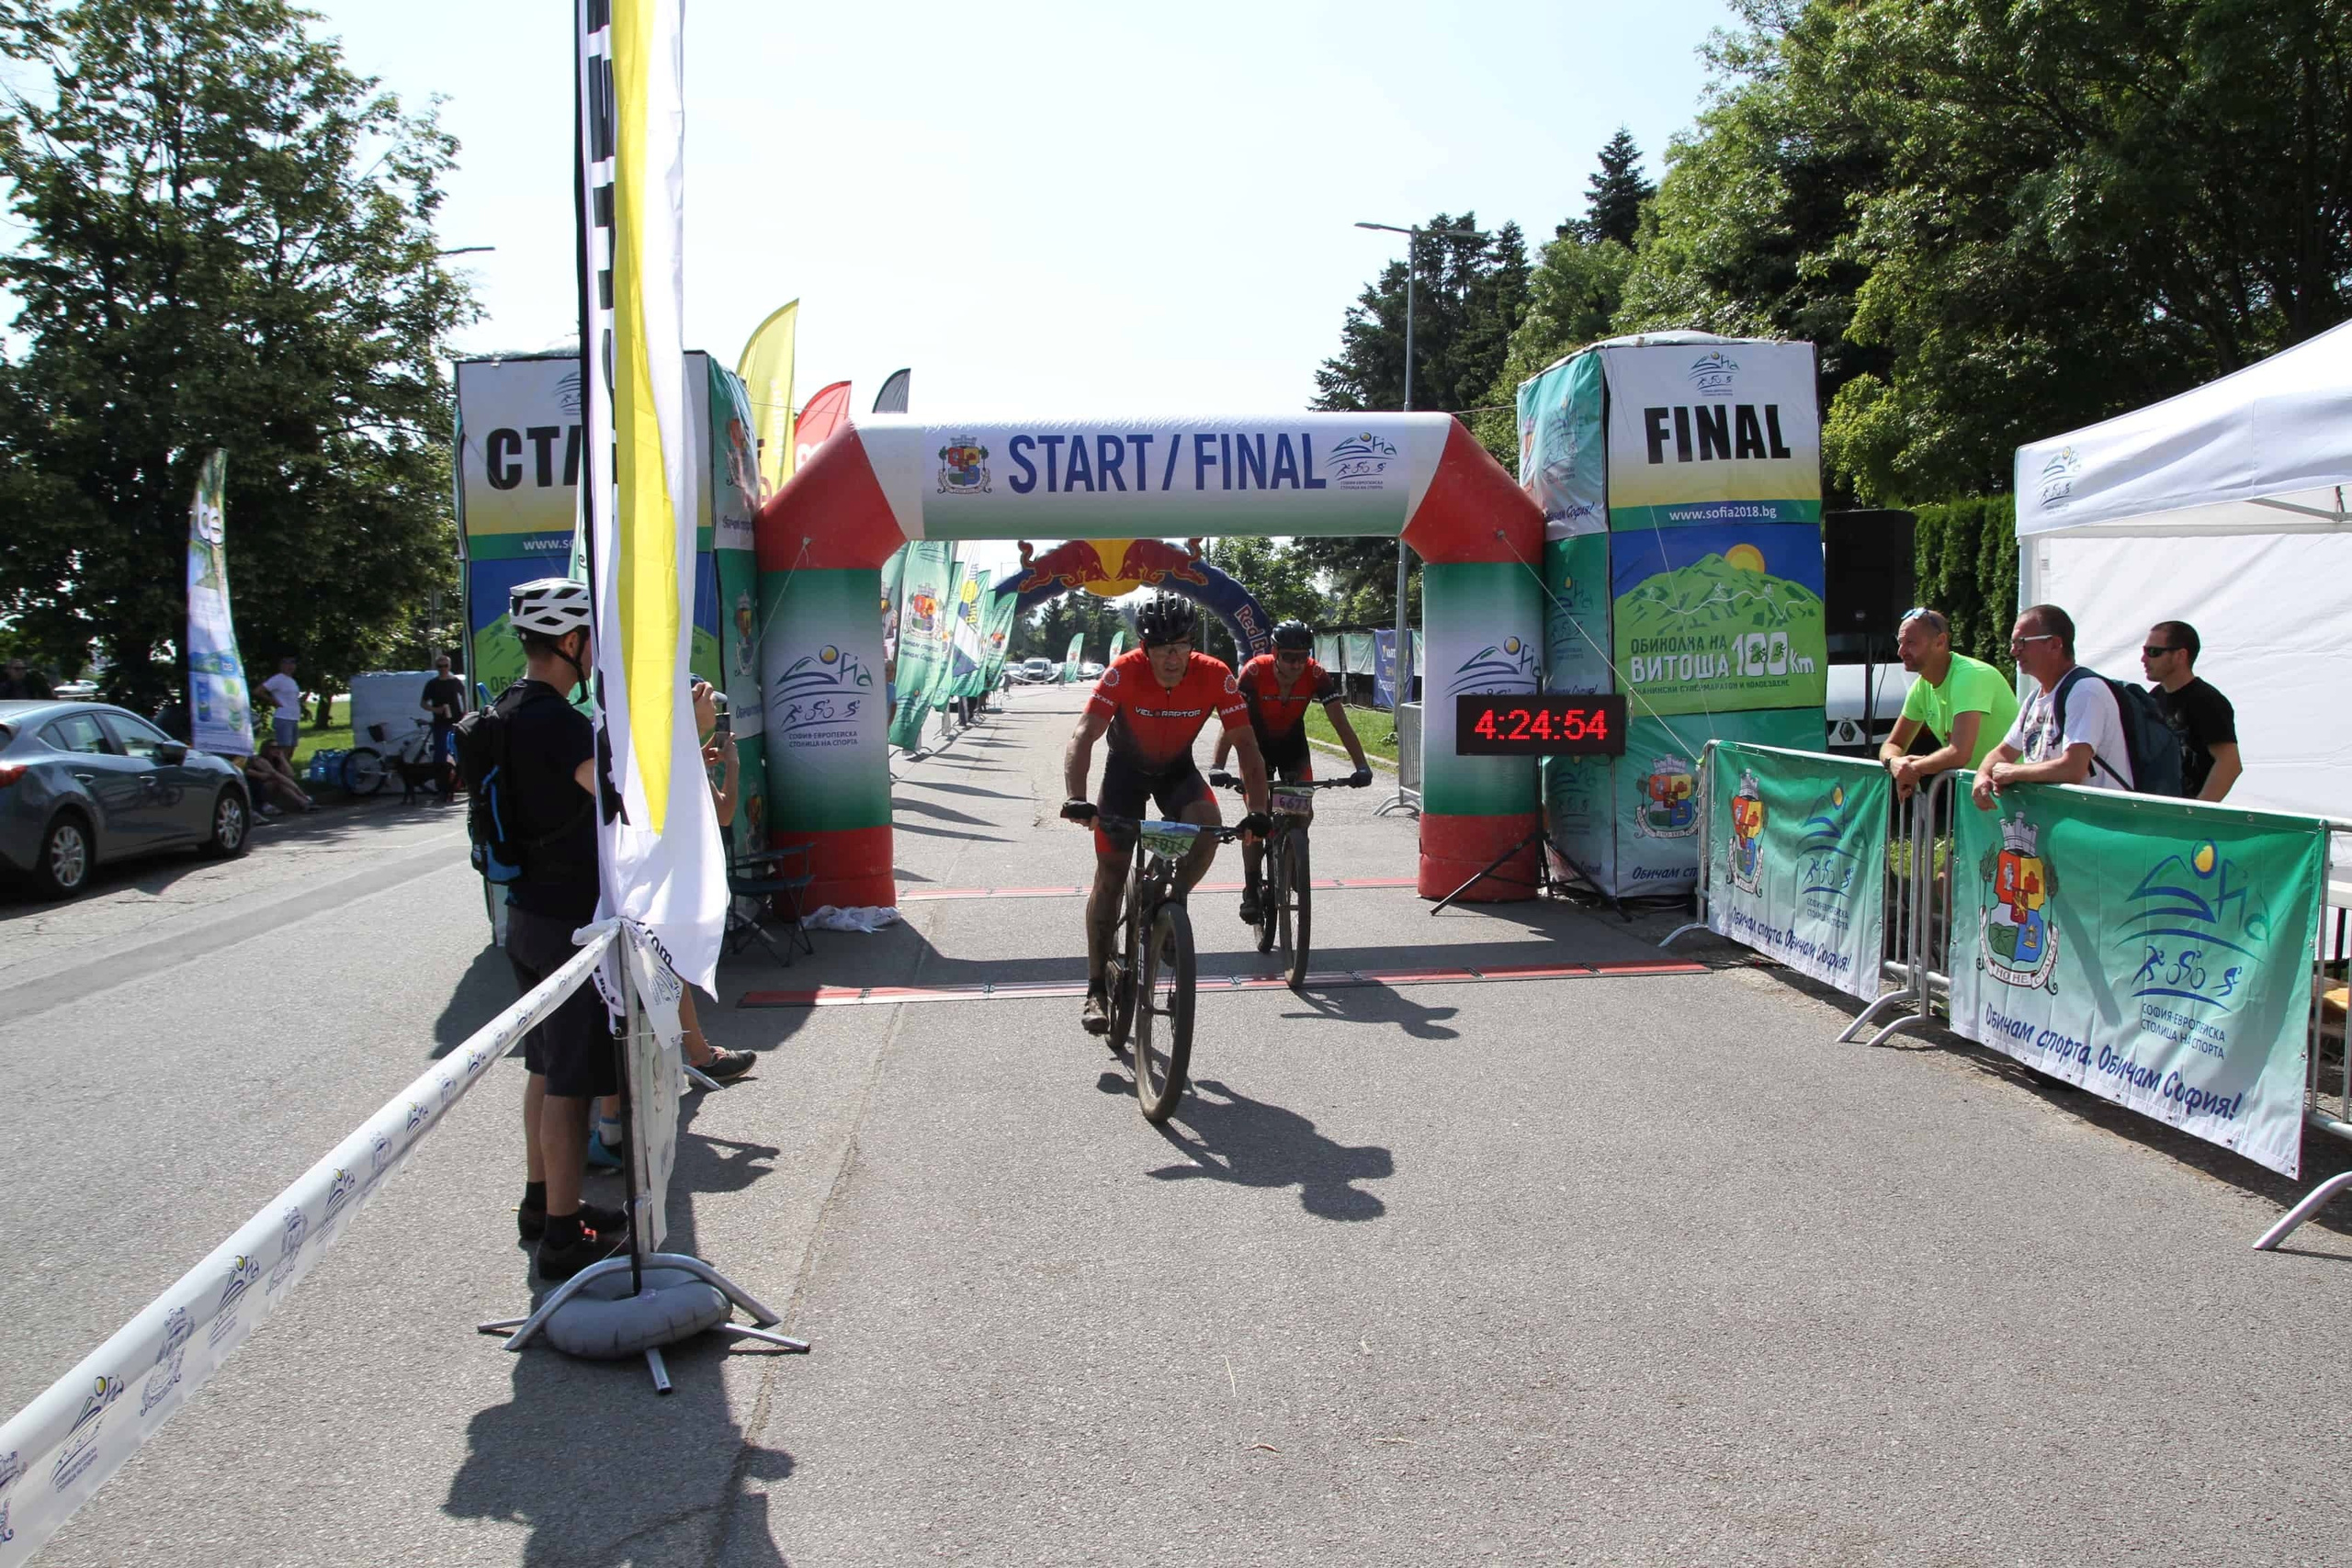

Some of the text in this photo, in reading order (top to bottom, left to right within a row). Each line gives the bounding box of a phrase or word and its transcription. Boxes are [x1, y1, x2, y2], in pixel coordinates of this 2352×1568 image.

[1644, 404, 1792, 465] FINAL
[1008, 434, 1154, 494] START
[1193, 433, 1328, 491] FINAL
[1668, 505, 1778, 522] www.sofia2018.bg
[1234, 604, 1266, 639] Red
[1630, 636, 1727, 655] ОБИКОЛКА НА
[1630, 653, 1731, 683] ВИТОША
[1474, 709, 1609, 740] 4:24:54
[1632, 865, 1680, 880] Обичам
[1784, 928, 1816, 959] Обичам
[1815, 942, 1853, 972] София!
[2141, 1018, 2224, 1060] СТОЛИЦА НА СПОРТА
[1985, 1002, 2243, 1121] Обичам спорта. Обичам София!
